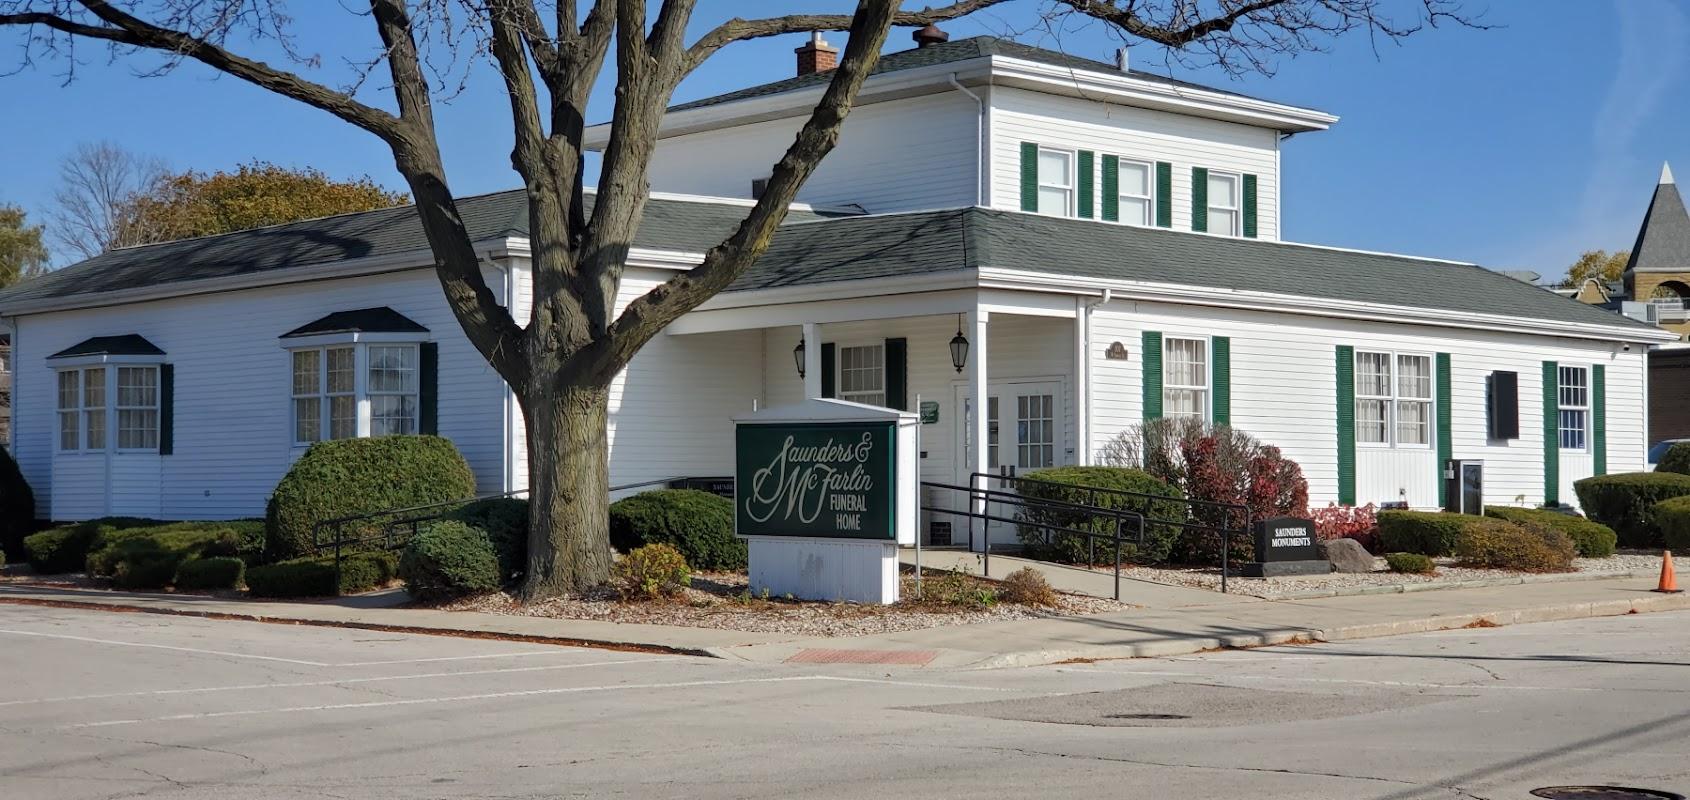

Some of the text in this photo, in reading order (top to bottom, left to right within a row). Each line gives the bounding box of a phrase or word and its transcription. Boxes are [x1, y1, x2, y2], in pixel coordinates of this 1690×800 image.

[753, 435, 854, 503] Saunders
[746, 463, 873, 523] McFarlin
[830, 494, 867, 511] FUNERAL
[836, 514, 861, 530] HOME
[1275, 527, 1307, 537] SAUNDERS
[1271, 537, 1311, 547] MONUMENTS
